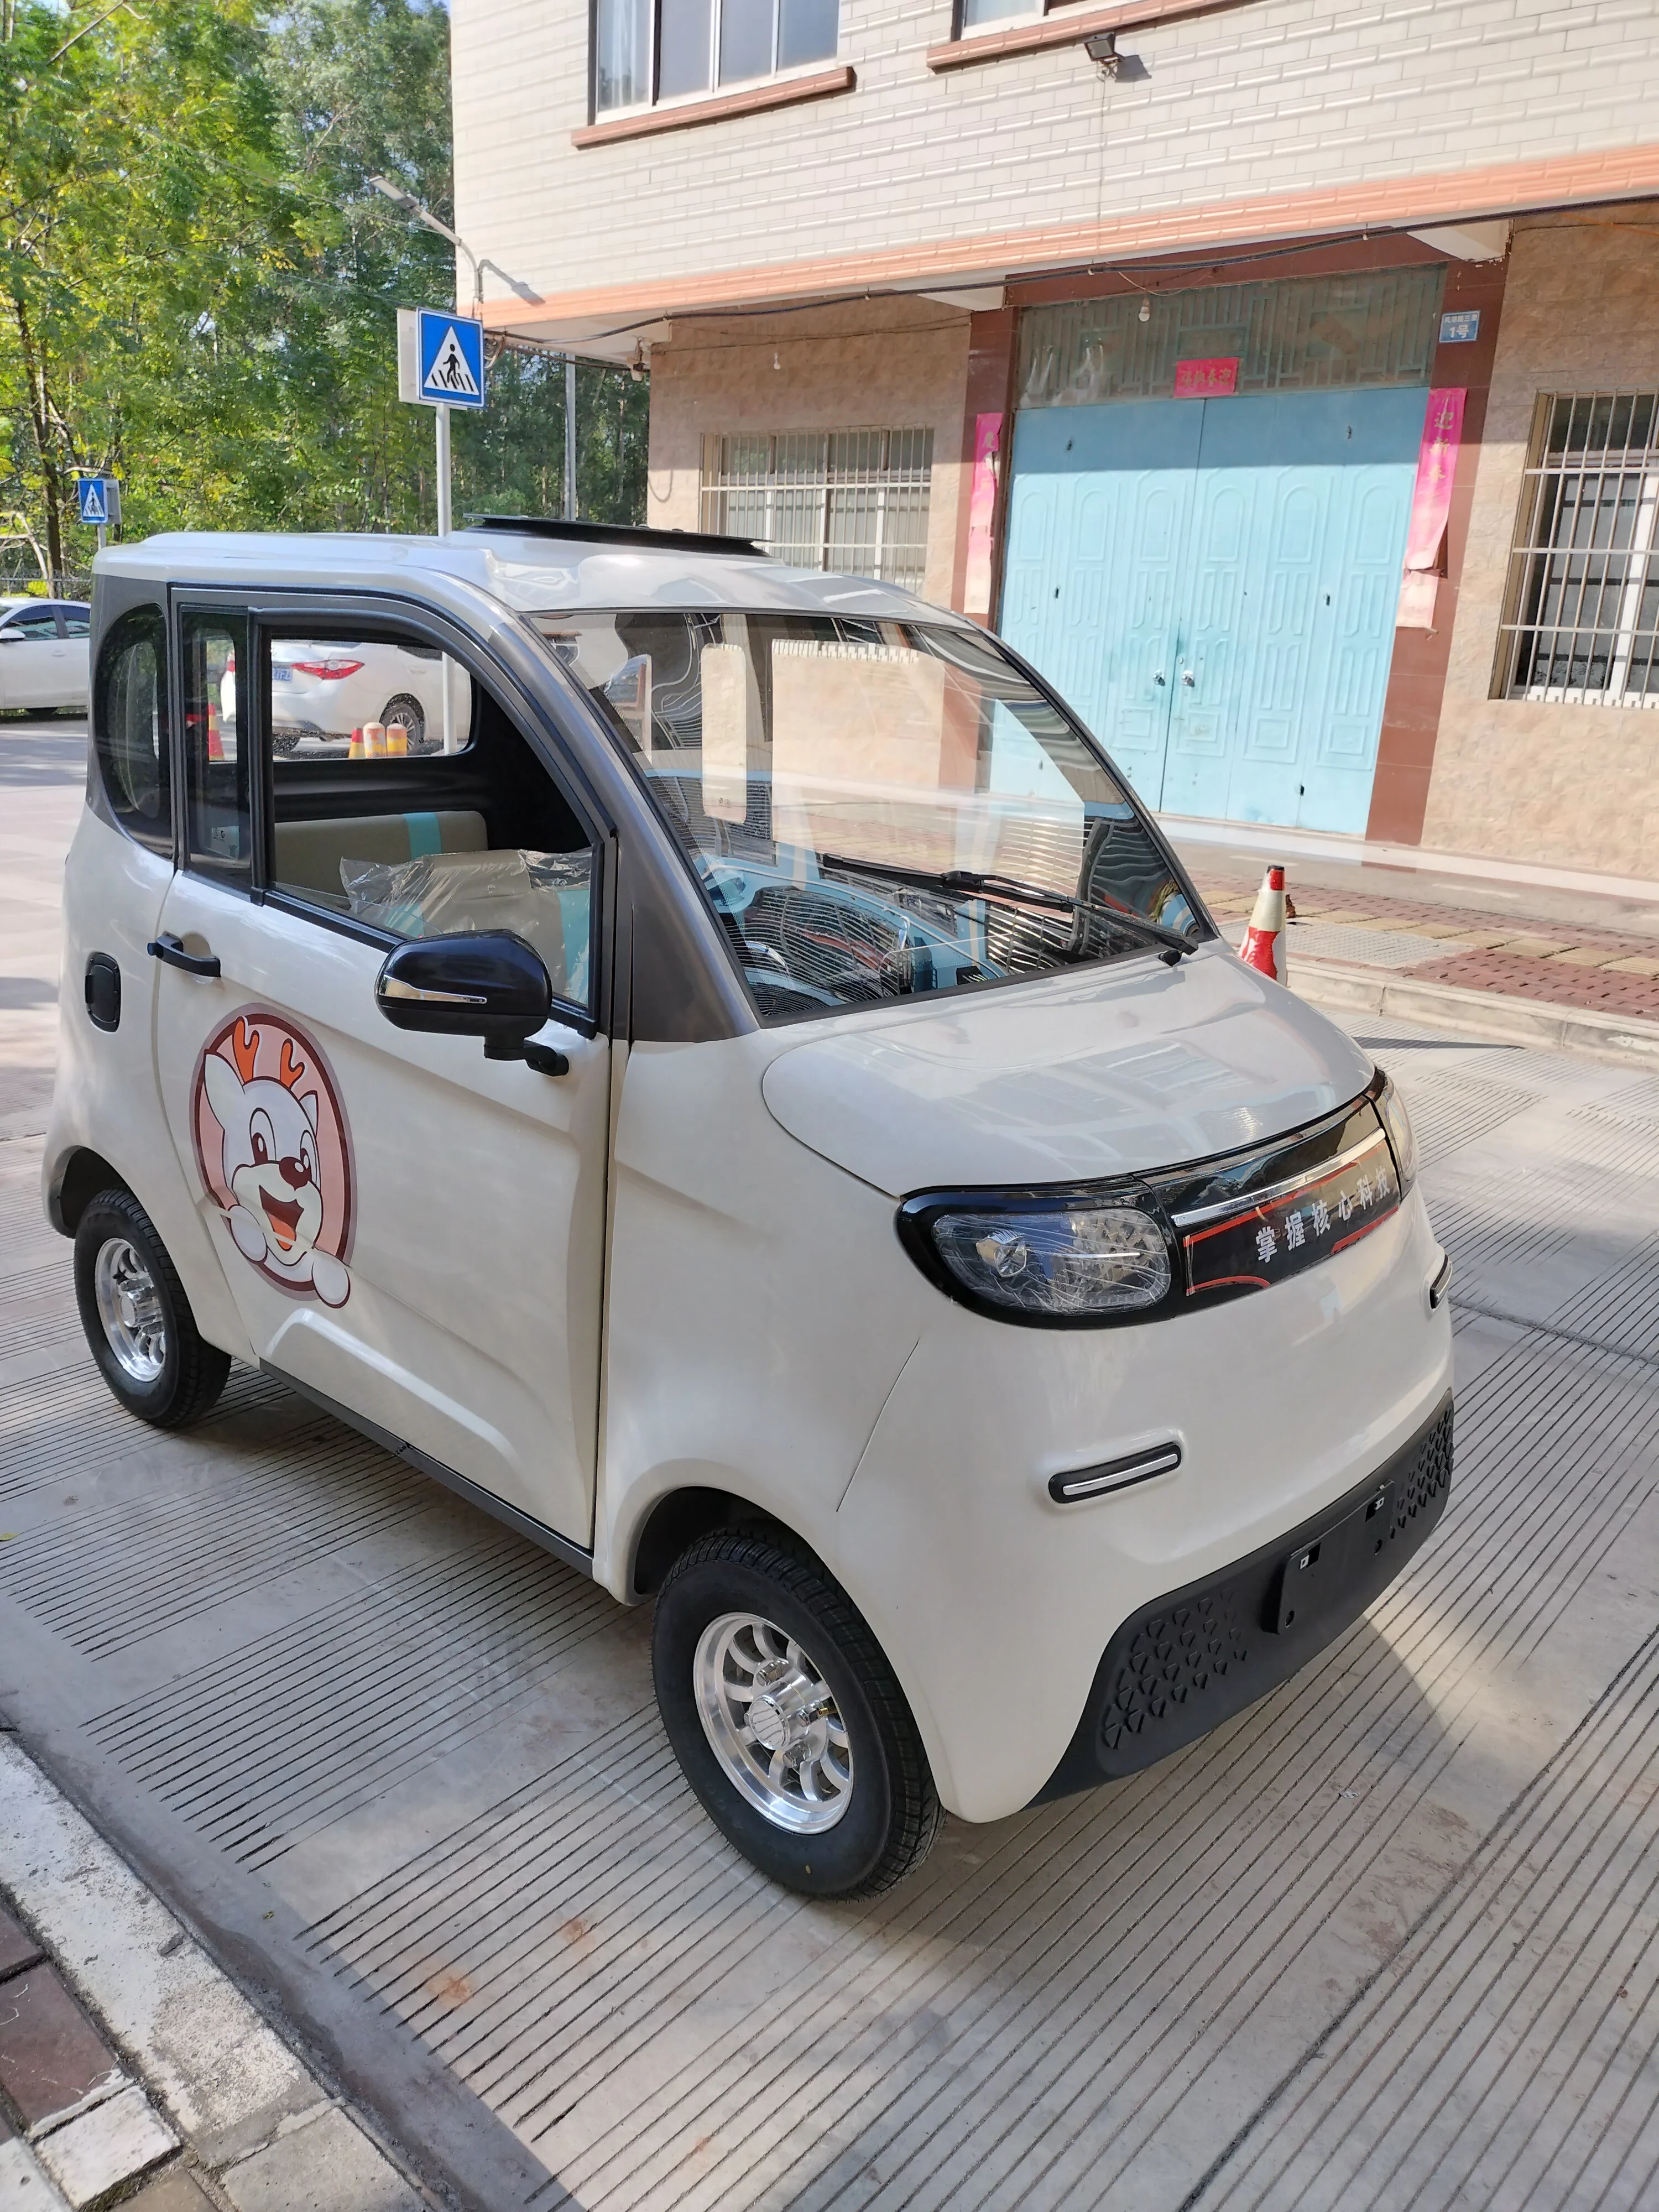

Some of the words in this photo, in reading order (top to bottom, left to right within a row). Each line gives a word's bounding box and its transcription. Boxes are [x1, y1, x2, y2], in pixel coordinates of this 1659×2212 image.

[1449, 324, 1469, 338] 1号
[1255, 1165, 1390, 1263] 掌握核心科技
